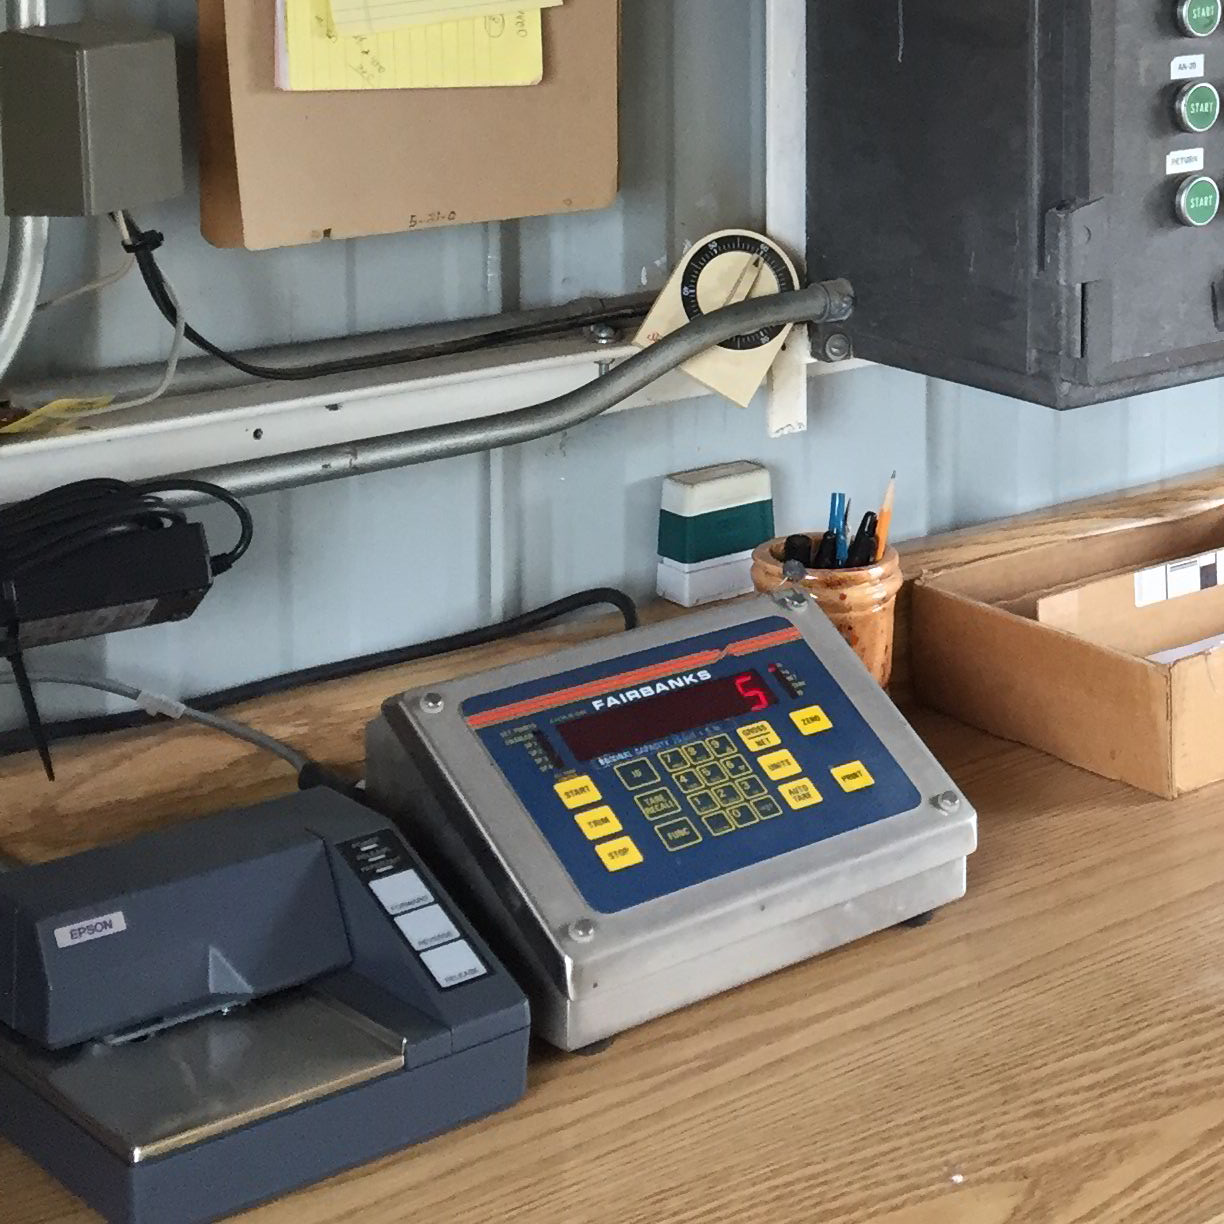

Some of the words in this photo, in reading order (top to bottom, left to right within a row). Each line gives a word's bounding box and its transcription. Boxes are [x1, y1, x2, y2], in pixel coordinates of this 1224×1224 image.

[1192, 5, 1215, 19] START
[1190, 102, 1214, 114] START
[1190, 195, 1213, 208] START
[591, 669, 712, 712] FAIRBANKS
[735, 672, 768, 712] 5
[801, 715, 821, 726] ZERO
[742, 724, 767, 737] GROSS
[755, 737, 770, 747] NET
[841, 770, 863, 782] PRINT
[563, 784, 591, 799] START
[788, 784, 809, 796] AUTO
[645, 800, 674, 816] RECALL
[667, 827, 691, 841] FUNC
[607, 847, 630, 860] STOP
[69, 919, 113, 940] EPSON
